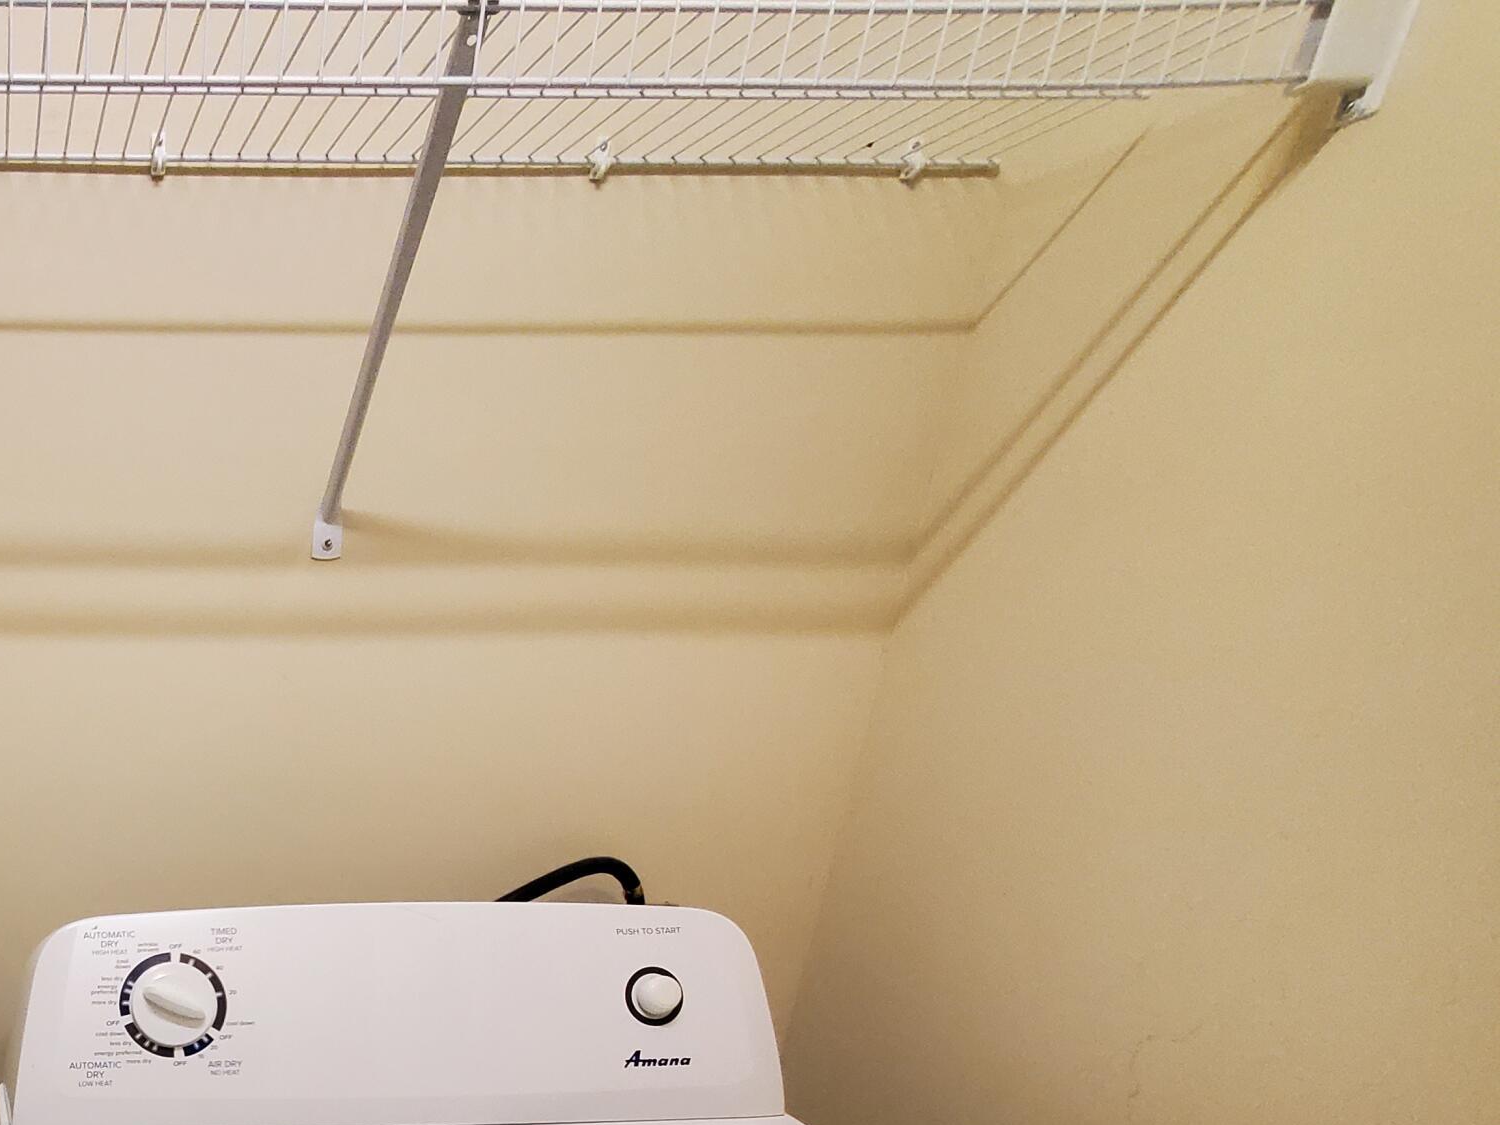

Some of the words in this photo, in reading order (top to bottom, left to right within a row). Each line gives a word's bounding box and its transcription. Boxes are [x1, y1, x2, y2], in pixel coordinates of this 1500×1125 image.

[211, 927, 238, 936] TIMED
[641, 927, 654, 935] TO
[655, 926, 681, 935] START
[84, 931, 136, 940] AUTOMATIC
[101, 940, 119, 949] DRY
[215, 936, 234, 945] DRY
[624, 1050, 691, 1068] Amana
[69, 1061, 122, 1070] AUTOMATIC
[208, 1060, 222, 1068] AIR
[224, 1060, 242, 1068] DRY
[86, 1071, 105, 1079] DRY
